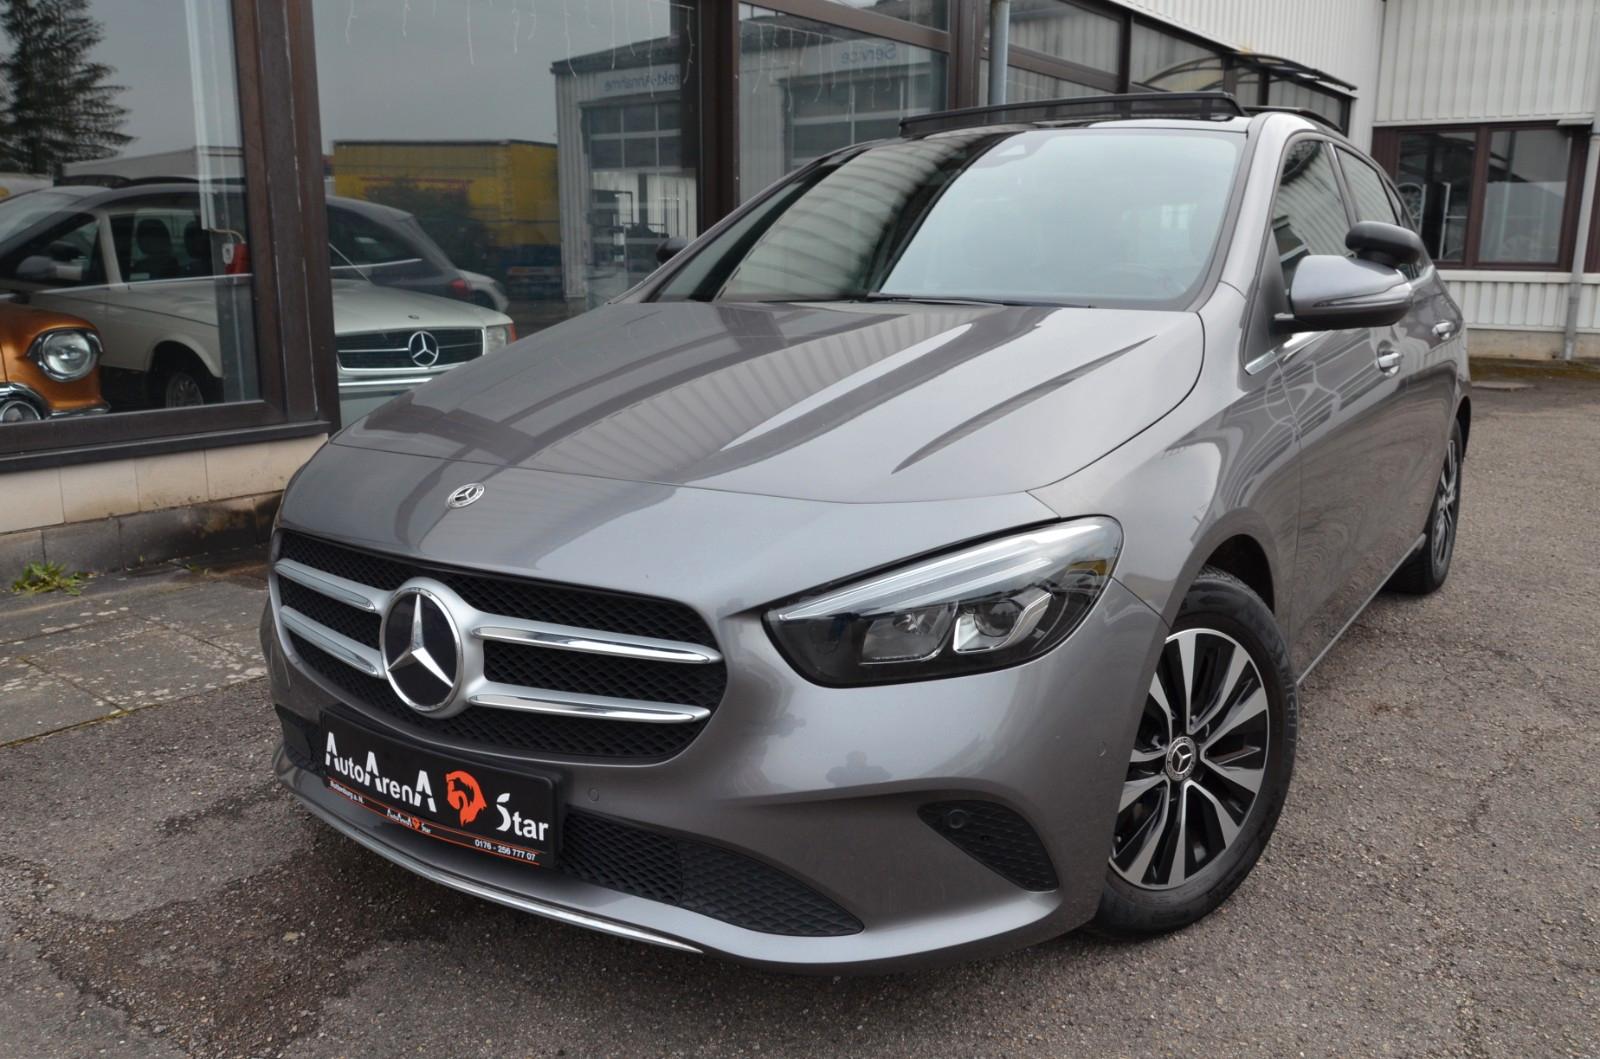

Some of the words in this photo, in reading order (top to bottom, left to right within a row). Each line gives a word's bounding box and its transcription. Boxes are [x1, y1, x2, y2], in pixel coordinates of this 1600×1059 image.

[325, 731, 438, 813] AutoArenA
[496, 792, 549, 841] Star
[512, 848, 525, 859] 777
